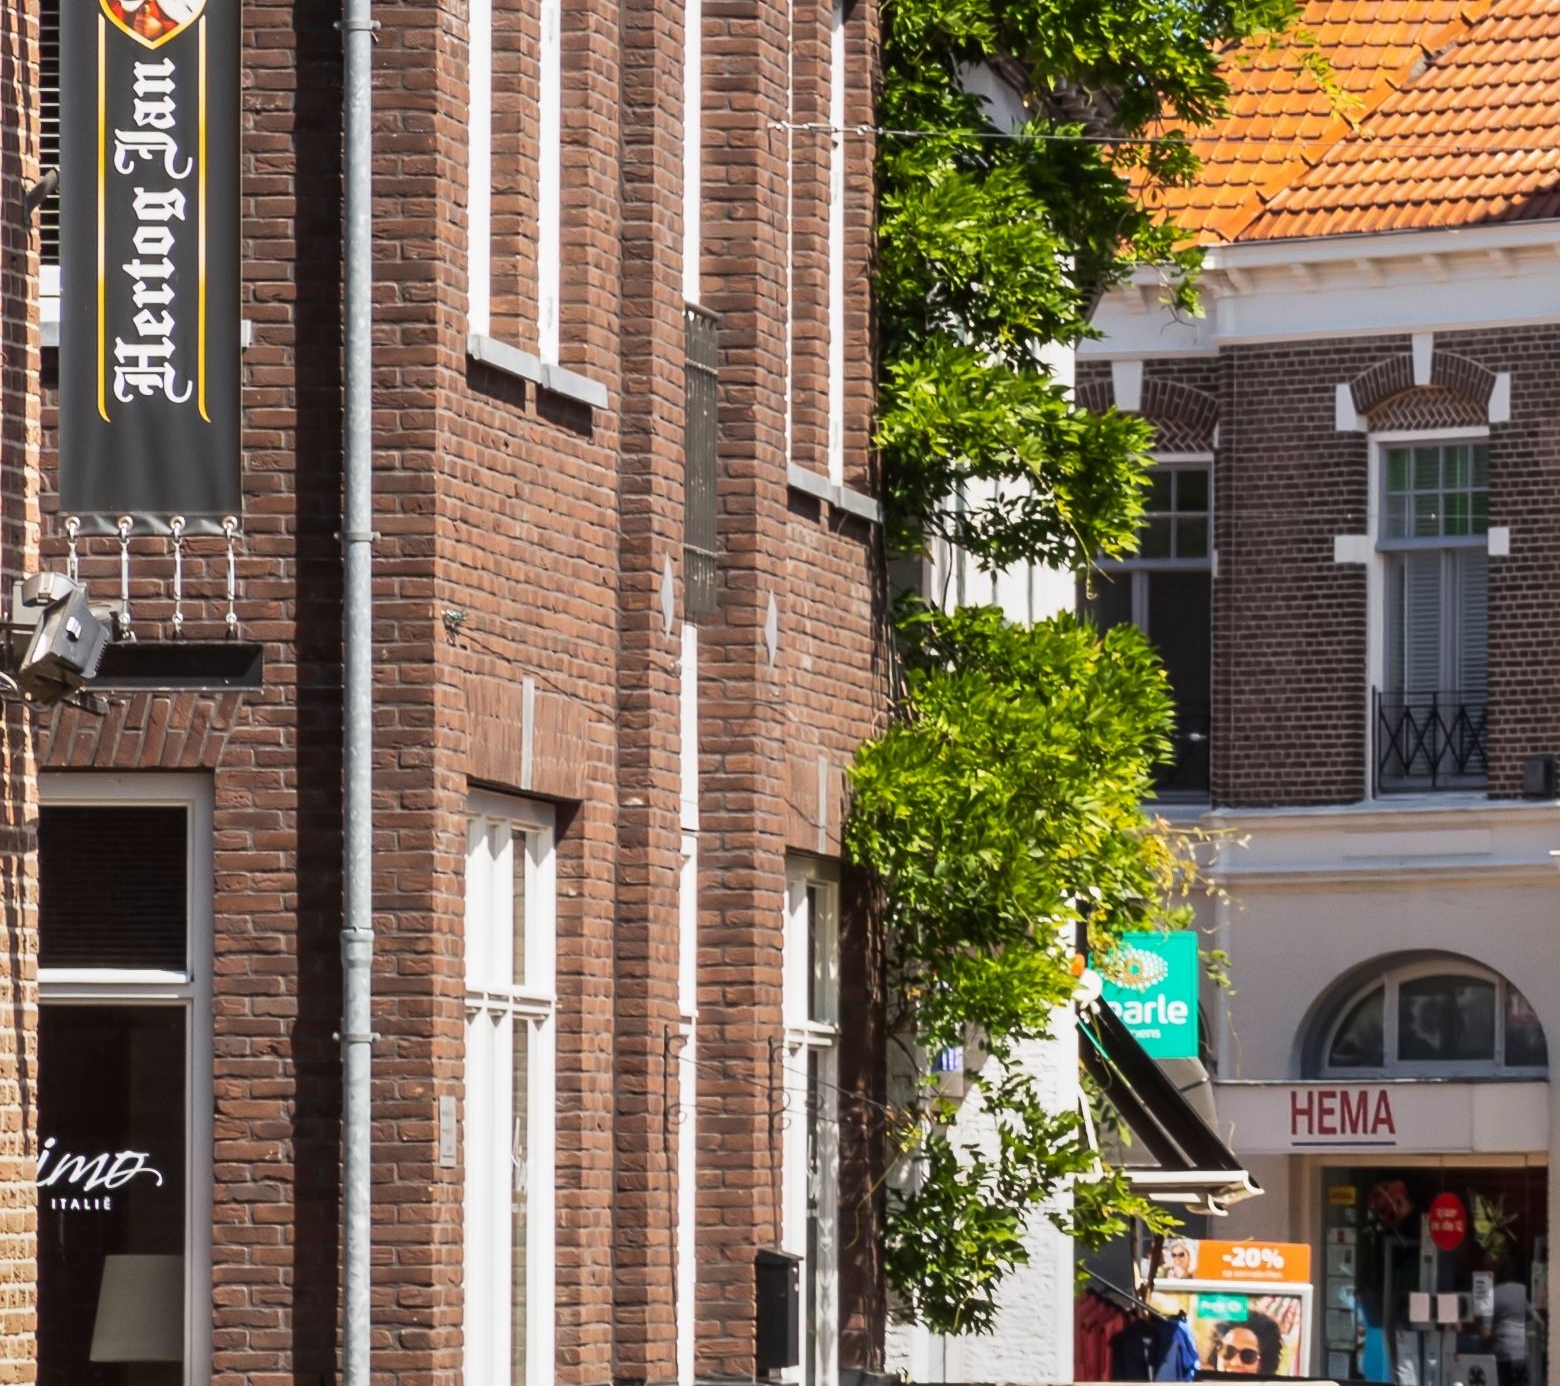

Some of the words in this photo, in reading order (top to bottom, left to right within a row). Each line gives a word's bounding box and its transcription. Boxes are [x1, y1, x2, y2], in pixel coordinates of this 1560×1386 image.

[114, 58, 193, 180] Jan
[114, 187, 193, 403] Hertog
[1106, 993, 1189, 1025] arle
[1290, 1089, 1397, 1136] HEMA
[36, 1137, 163, 1192] imo
[1221, 1246, 1285, 1269] -20%
